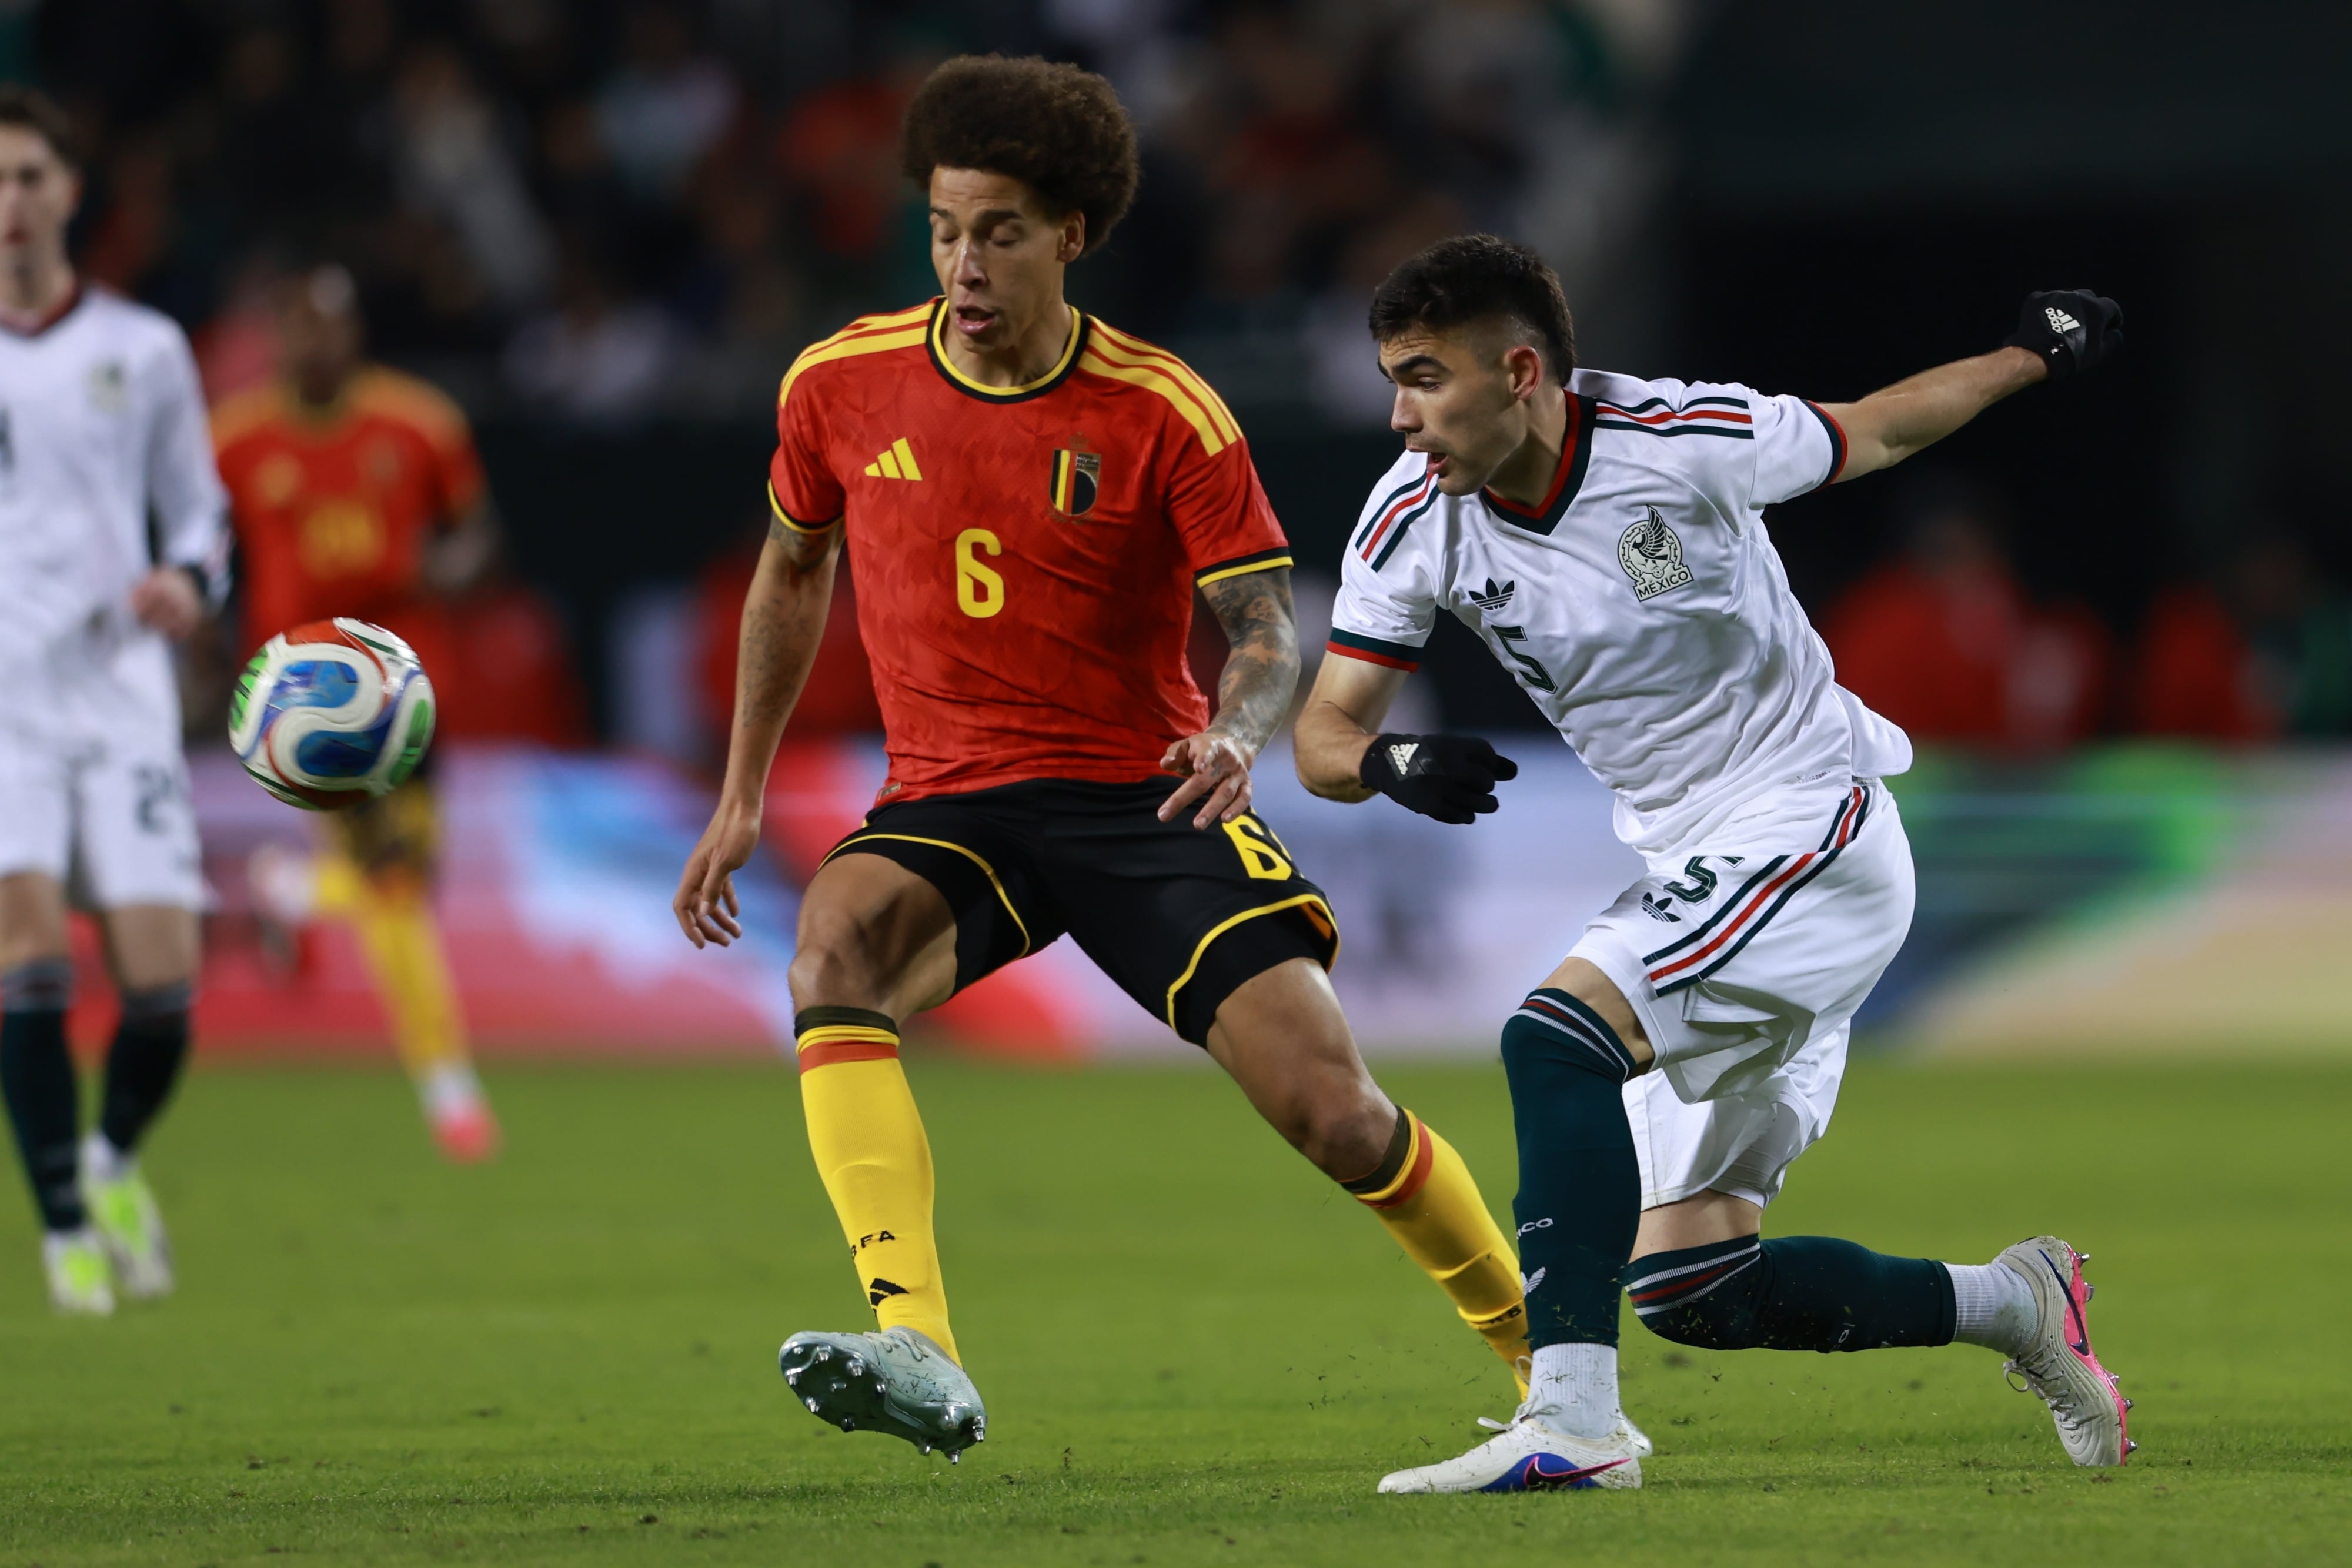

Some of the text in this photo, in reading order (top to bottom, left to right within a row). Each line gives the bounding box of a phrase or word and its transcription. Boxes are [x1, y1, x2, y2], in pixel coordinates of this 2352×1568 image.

[956, 529, 1004, 618] 6
[1638, 571, 1688, 597] MÉXICO
[1491, 625, 1558, 694] 5
[1222, 815, 1292, 880] 6
[1663, 856, 1745, 906] 5
[1516, 1218, 1553, 1239] ICO
